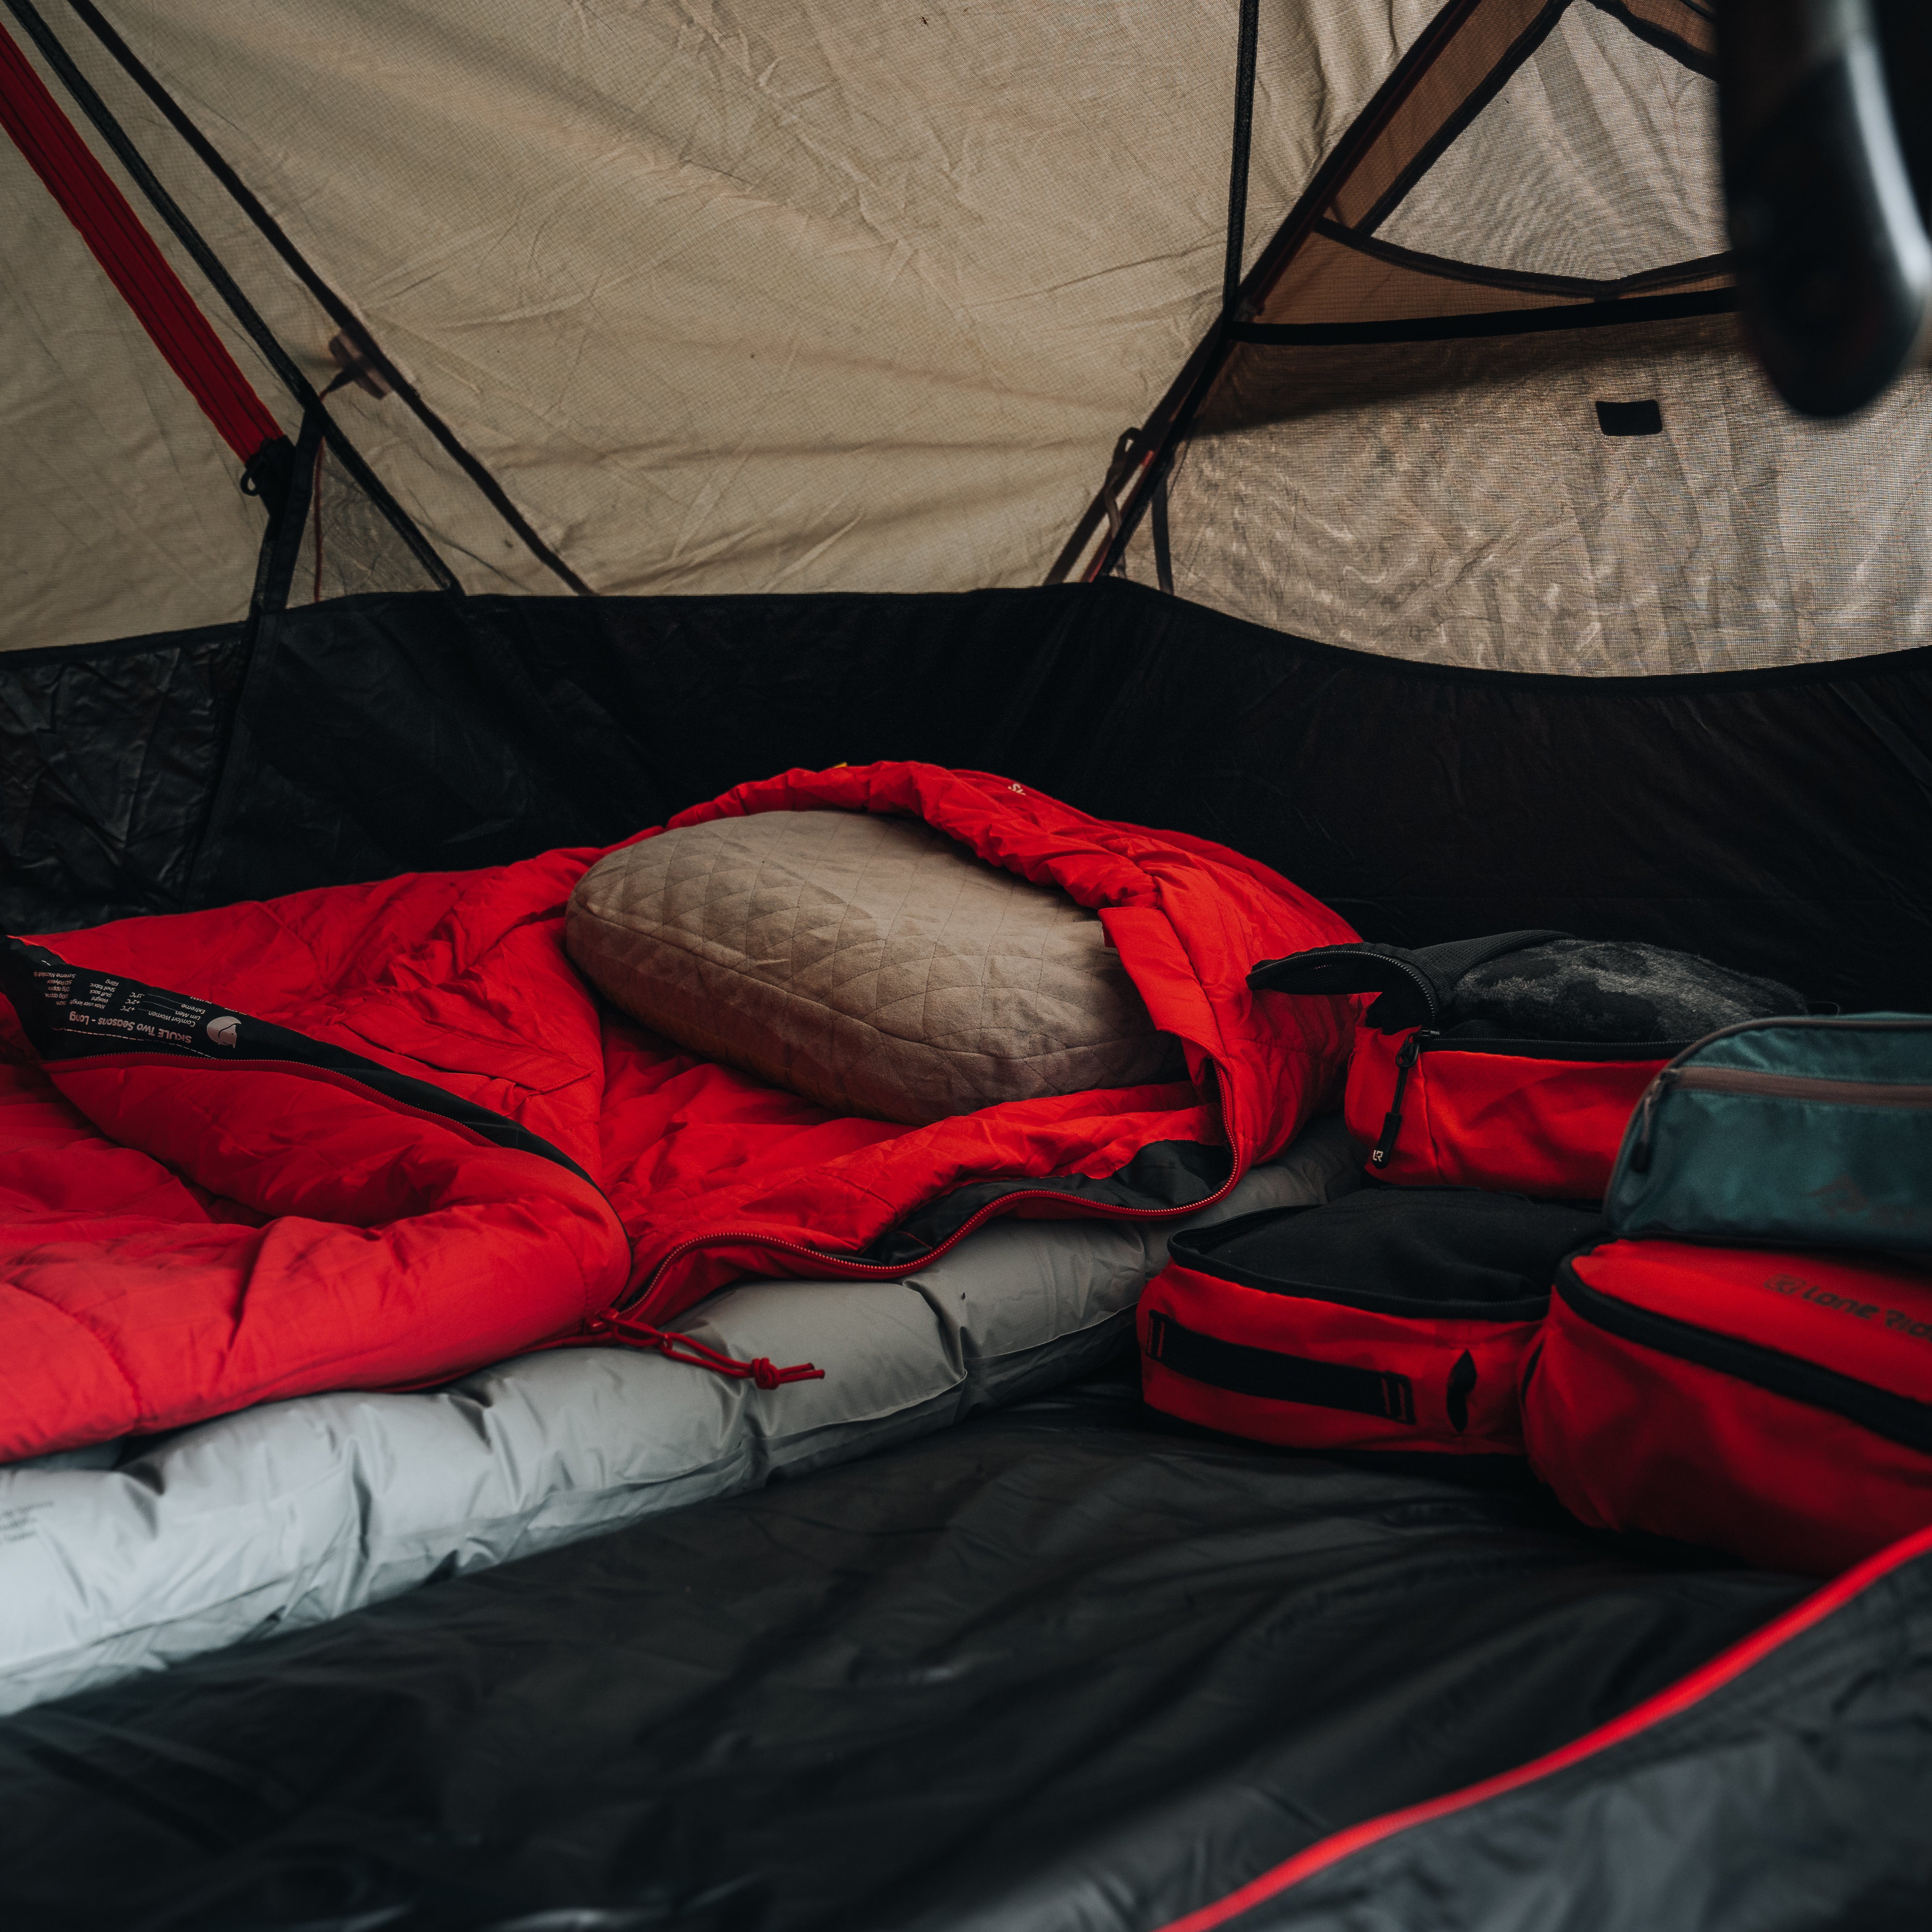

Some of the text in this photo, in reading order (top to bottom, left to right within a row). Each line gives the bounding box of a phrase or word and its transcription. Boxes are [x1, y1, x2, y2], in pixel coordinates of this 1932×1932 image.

[181, 1004, 205, 1014] Extreme
[70, 1011, 89, 1025] Long
[98, 1018, 135, 1031] Seasons
[171, 1017, 195, 1027] Comfort
[137, 1023, 155, 1036] Two
[158, 1028, 192, 1043] SKULE
